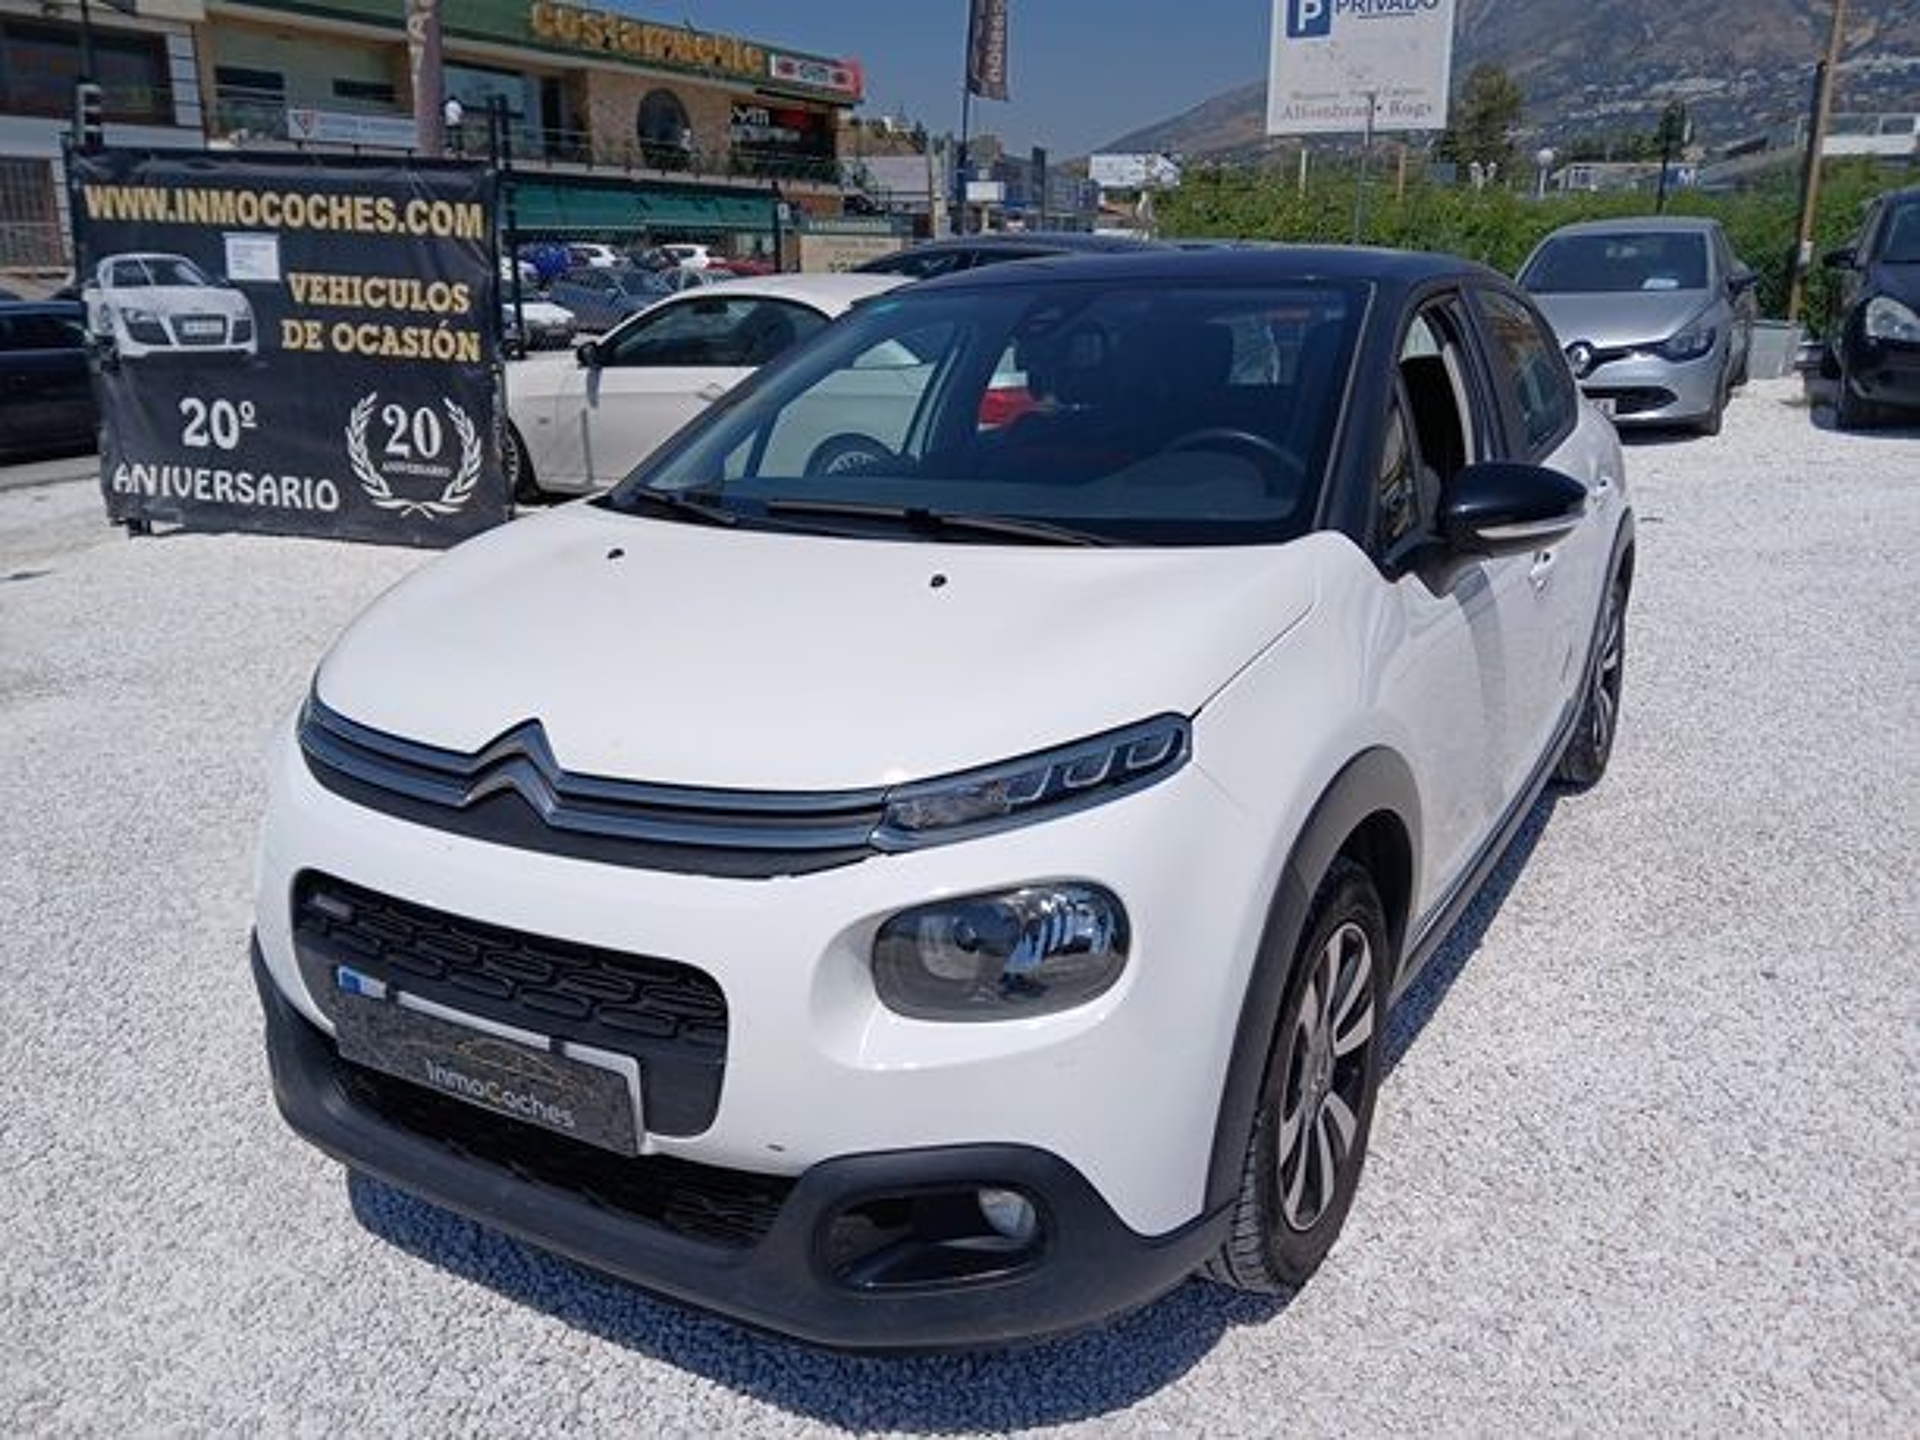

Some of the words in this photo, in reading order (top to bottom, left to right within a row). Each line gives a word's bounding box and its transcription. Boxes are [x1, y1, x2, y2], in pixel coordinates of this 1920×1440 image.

[84, 184, 484, 239] WWW.INMOCOCHES.COM
[288, 272, 471, 314] VEHICULOS
[281, 319, 325, 351] DE
[331, 319, 482, 362] OCASIÓN
[179, 397, 258, 450] 20º
[382, 403, 441, 459] 20
[112, 463, 340, 511] ANIVERSARIO
[425, 1059, 576, 1129] InmoCoches
